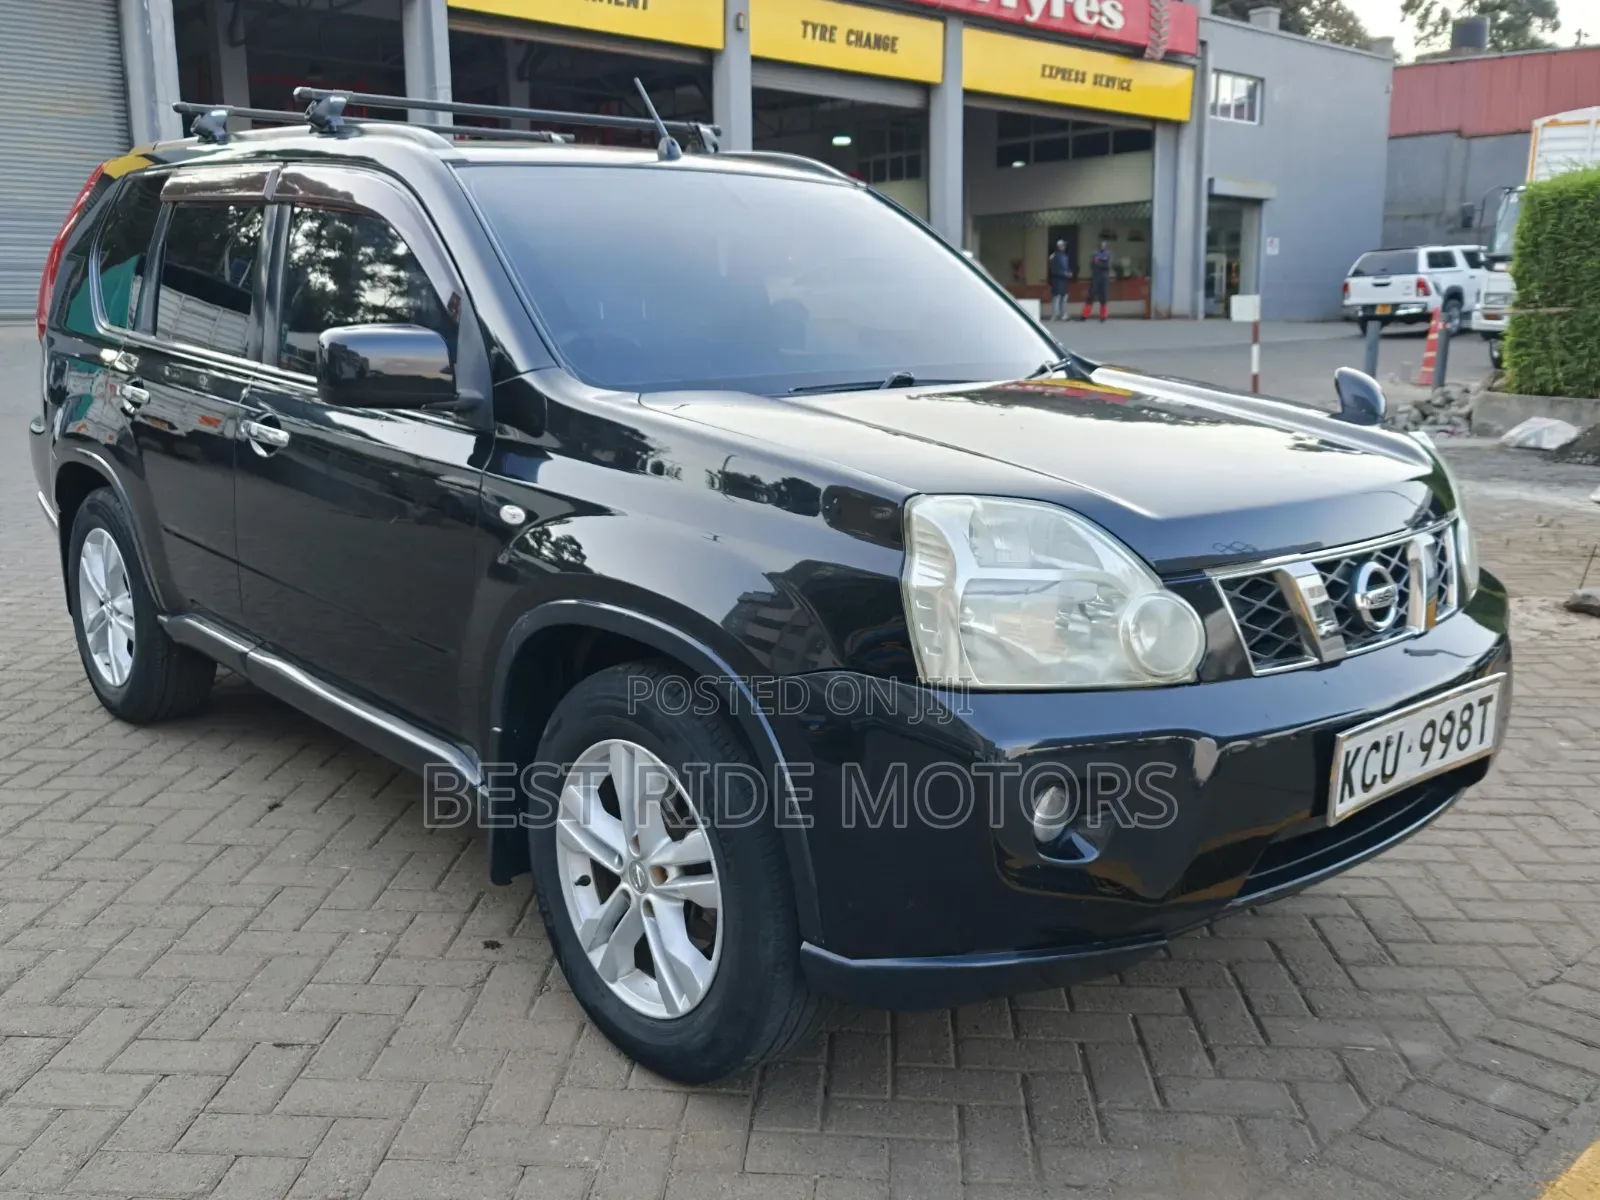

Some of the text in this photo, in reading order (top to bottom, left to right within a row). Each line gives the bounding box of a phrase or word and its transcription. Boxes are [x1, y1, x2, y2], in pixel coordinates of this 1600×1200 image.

[1000, 0, 1125, 30] yres
[801, 20, 899, 54] TYRE CHANGE
[1041, 64, 1133, 92] EXPRESS SERVICE
